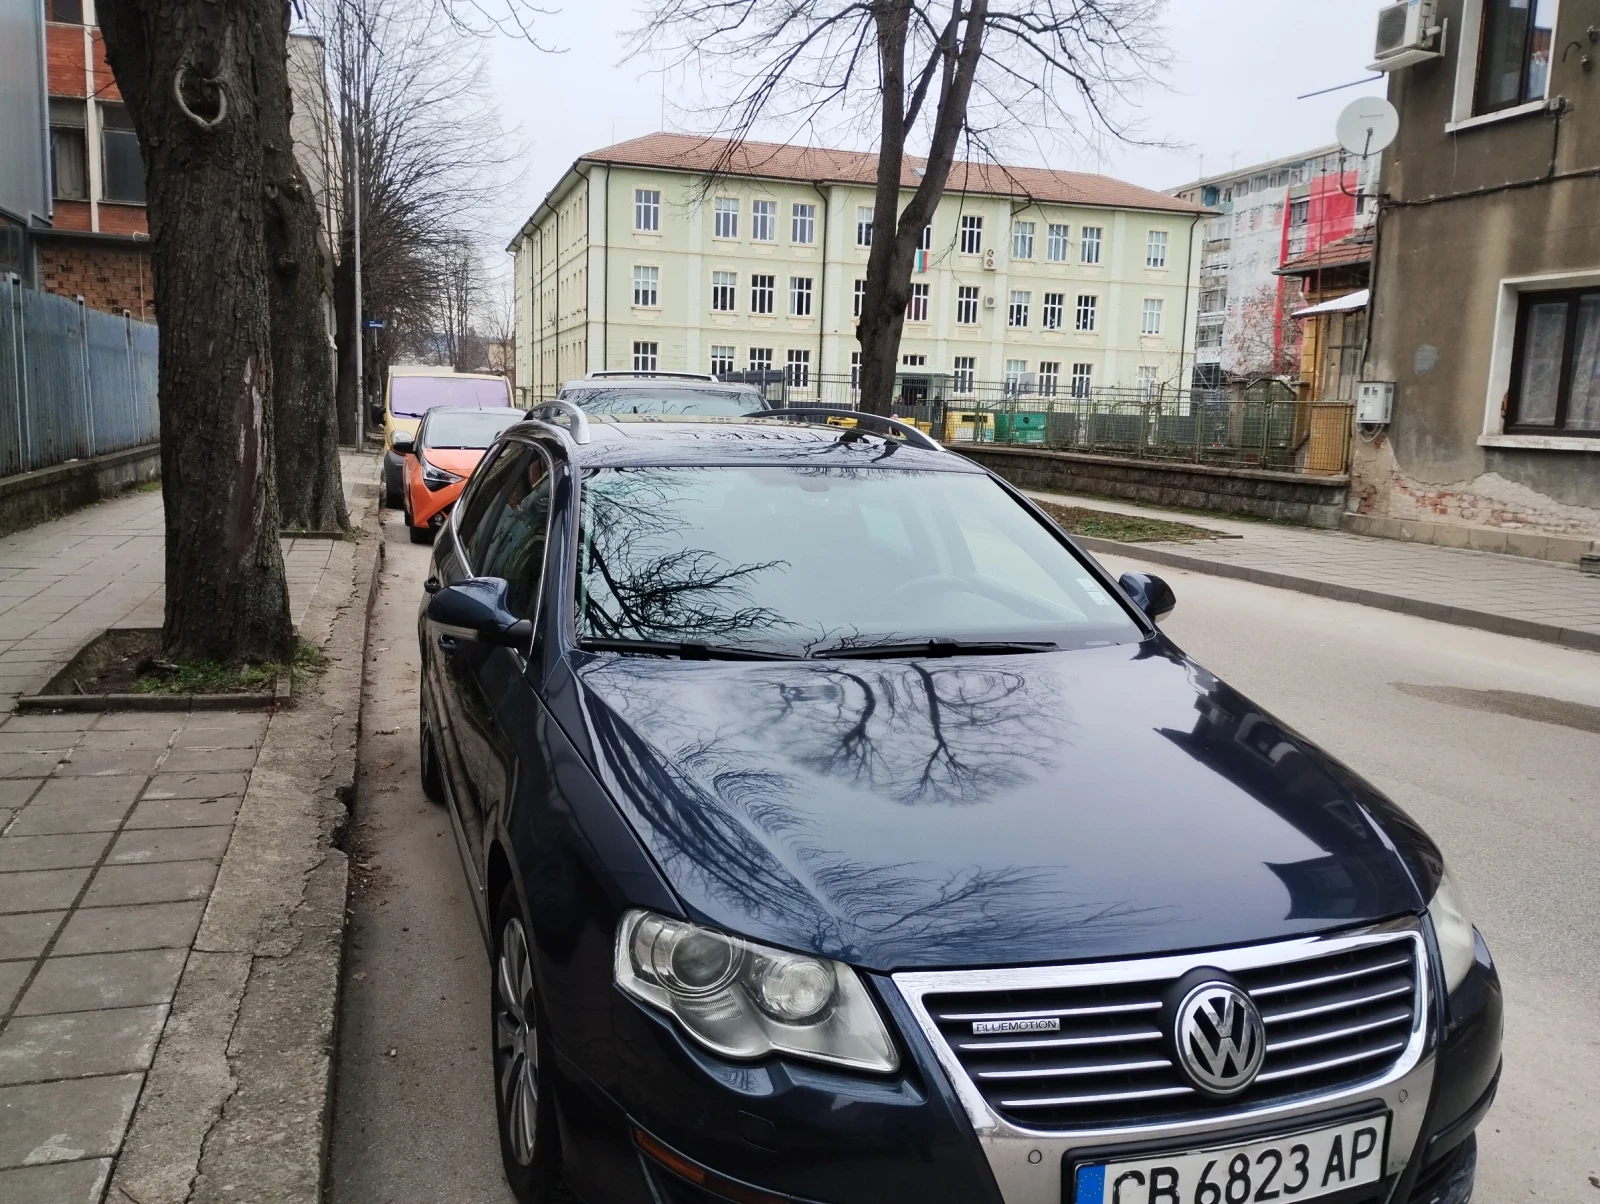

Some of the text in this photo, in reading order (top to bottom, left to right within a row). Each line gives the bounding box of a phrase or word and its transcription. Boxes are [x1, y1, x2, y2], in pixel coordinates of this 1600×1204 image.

[976, 1020, 1057, 1032] BLUEMOTION
[1194, 1143, 1310, 1204] 6823
[1320, 1126, 1377, 1187] AP
